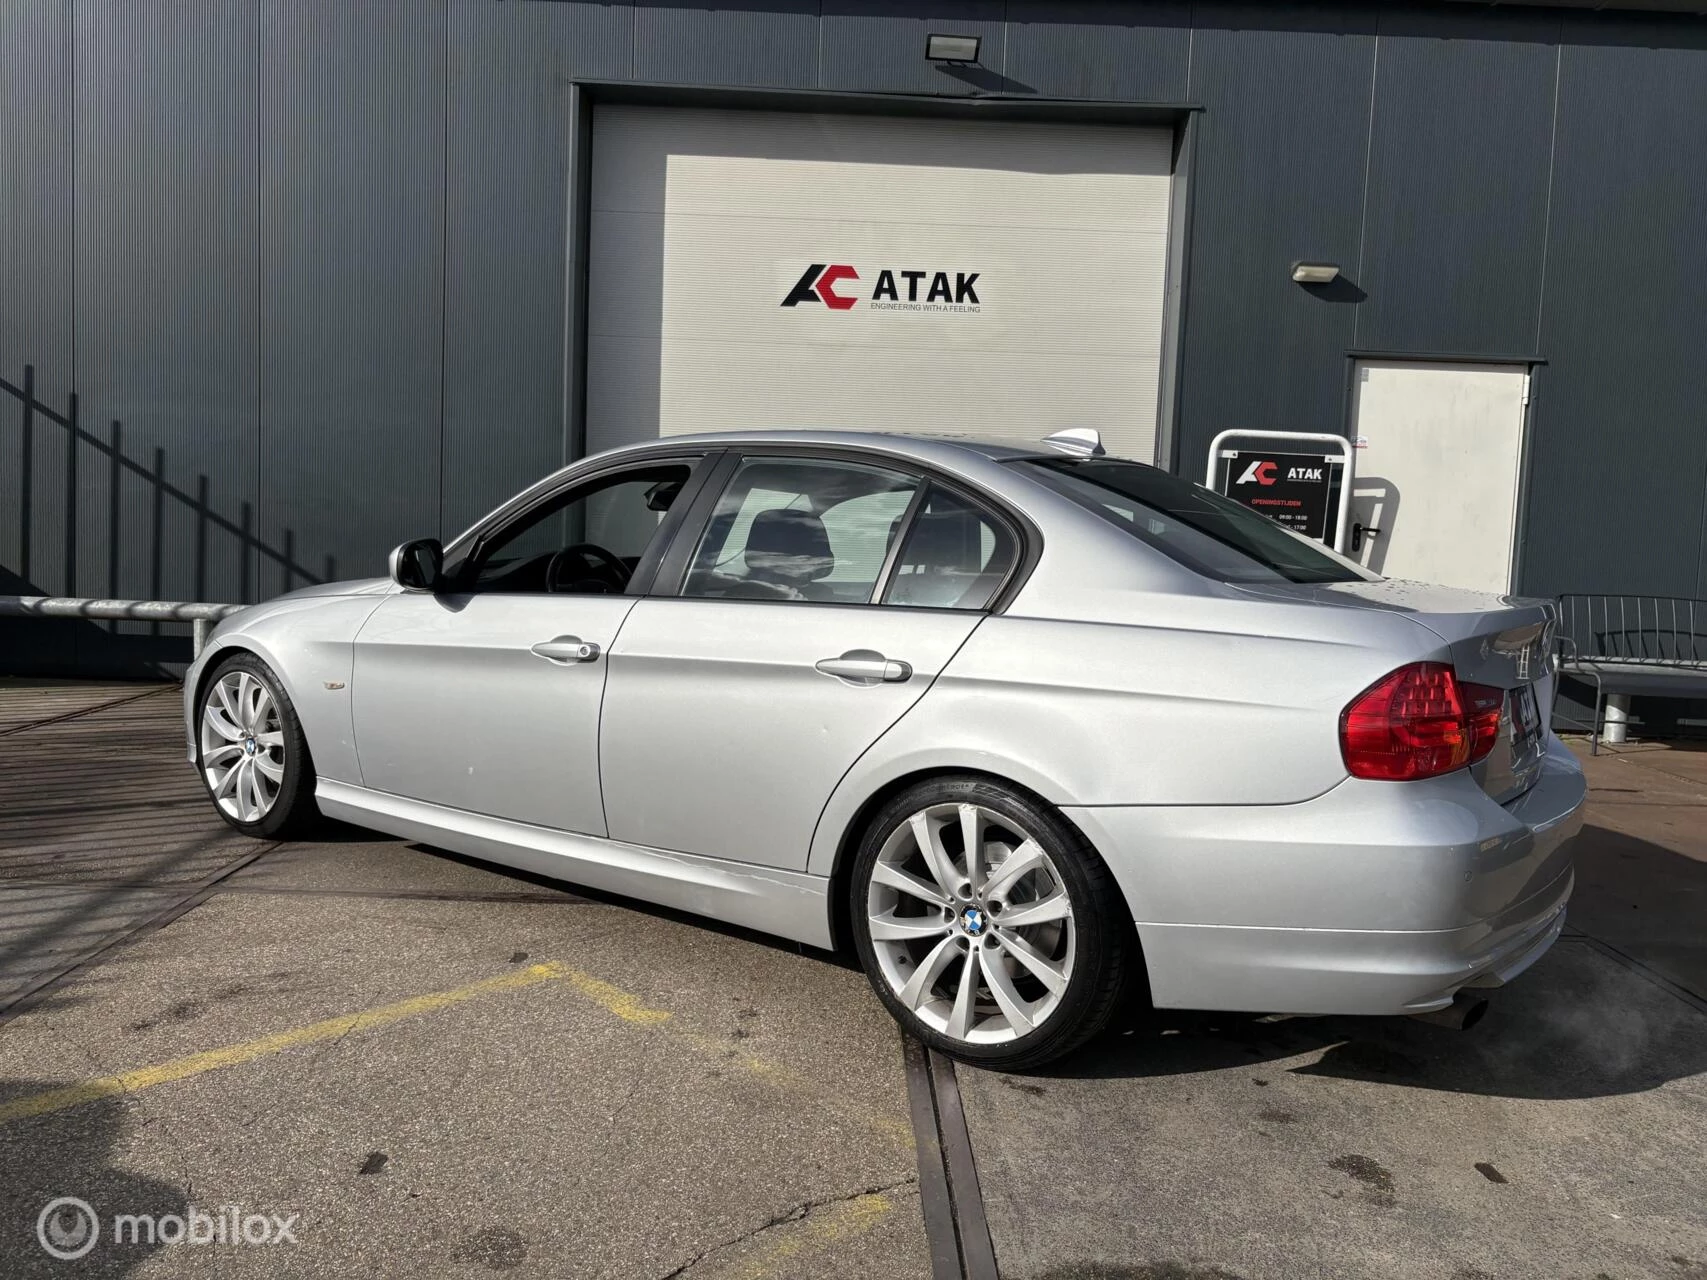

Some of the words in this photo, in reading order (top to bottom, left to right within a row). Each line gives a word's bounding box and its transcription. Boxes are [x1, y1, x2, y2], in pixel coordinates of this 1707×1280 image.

[872, 270, 980, 304] ATAK
[871, 303, 920, 311] ENGINEERING
[923, 304, 941, 312] WITH
[949, 305, 980, 313] FEELING
[1287, 467, 1322, 480] ATAK
